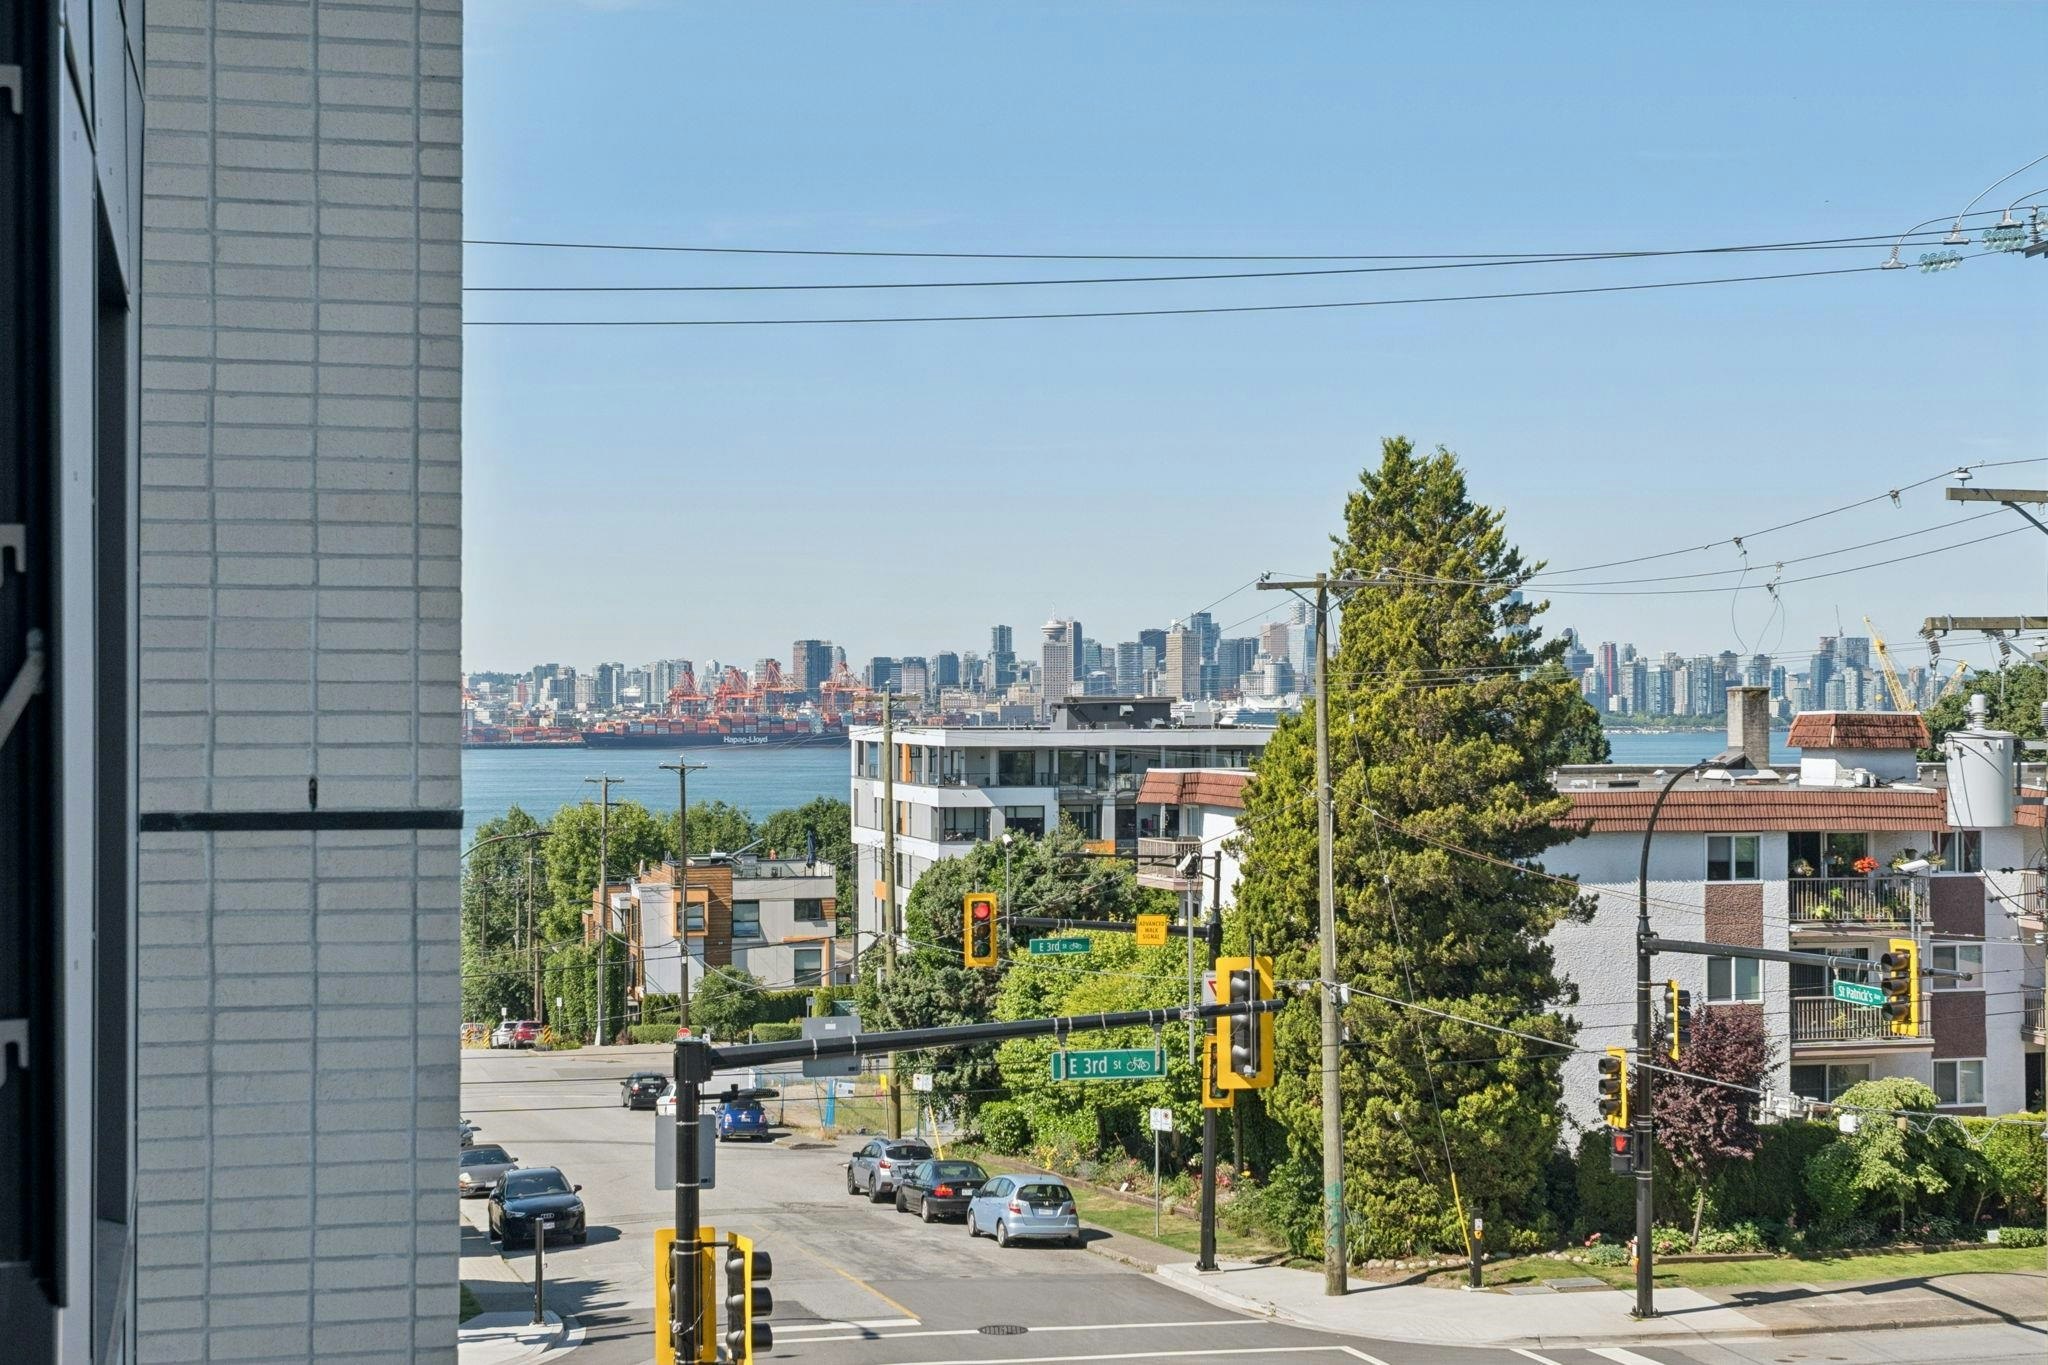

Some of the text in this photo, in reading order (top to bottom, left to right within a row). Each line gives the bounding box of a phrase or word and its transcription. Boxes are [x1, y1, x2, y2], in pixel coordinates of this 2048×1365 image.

[723, 736, 768, 744] Hapag-Lloyd
[1040, 942, 1044, 951] E
[1046, 941, 1060, 951] 3rd
[1846, 987, 1873, 1002] Patrick's
[1070, 1058, 1078, 1075] E
[1083, 1055, 1108, 1074] 3rd
